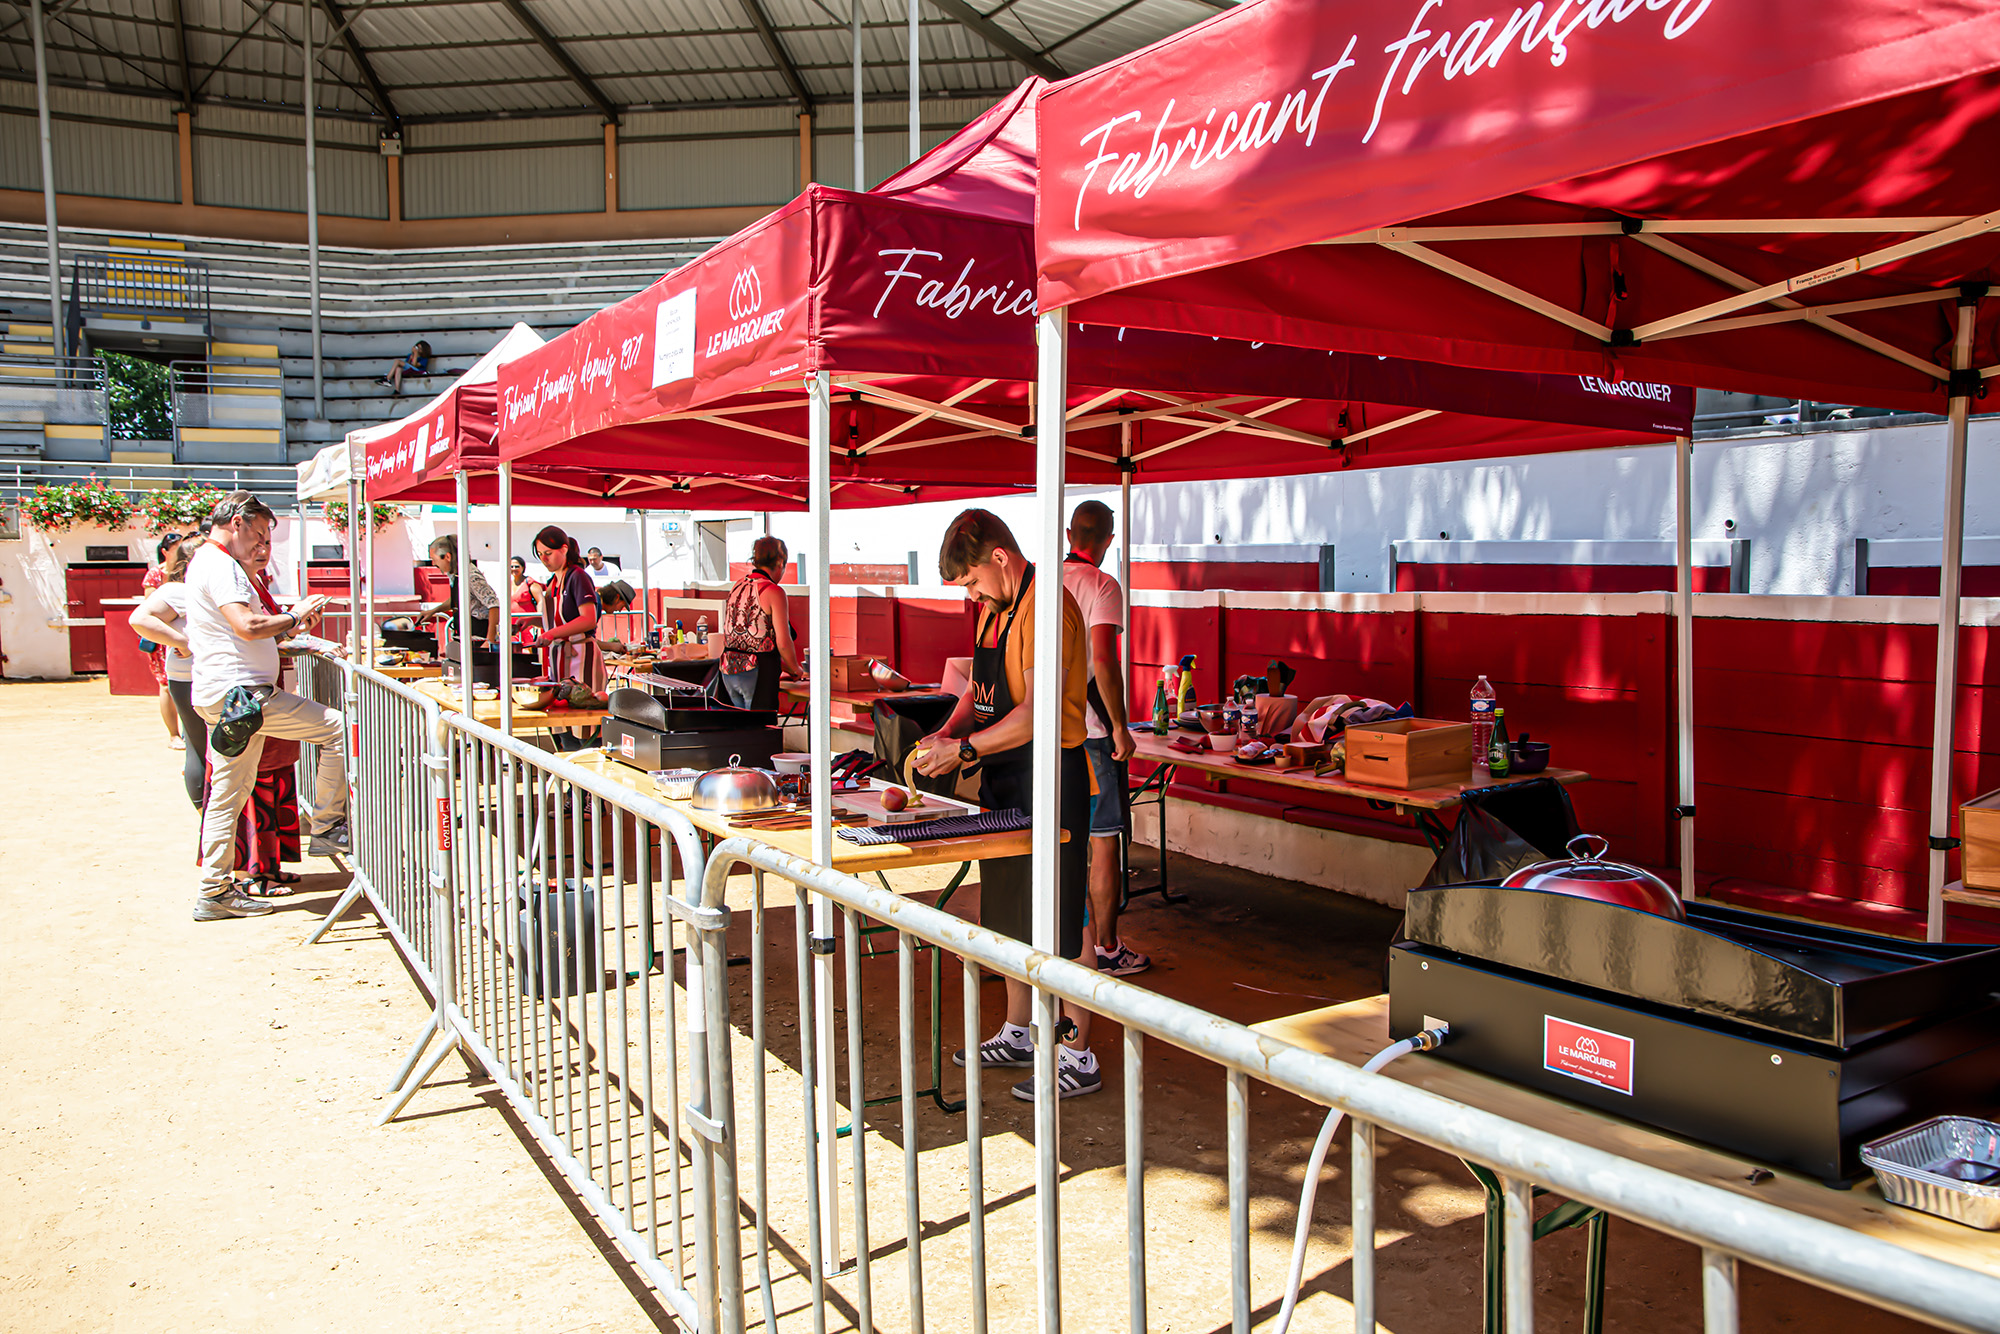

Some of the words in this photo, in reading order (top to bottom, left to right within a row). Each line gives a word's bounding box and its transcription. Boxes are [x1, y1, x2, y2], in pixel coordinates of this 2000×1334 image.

[1074, 34, 1357, 231] Fabricant
[1362, 0, 1713, 144] franç
[873, 247, 1038, 319] Fabric
[705, 332, 722, 358] LE
[719, 308, 785, 353] MARQUIER
[503, 376, 540, 431] Fabricant
[580, 342, 616, 394] depuis
[1578, 375, 1599, 393] LE
[1597, 377, 1672, 402] MARQUIER
[442, 813, 451, 848] ALTRAD
[1558, 1045, 1569, 1056] LE
[1569, 1048, 1617, 1070] MARQUIER
